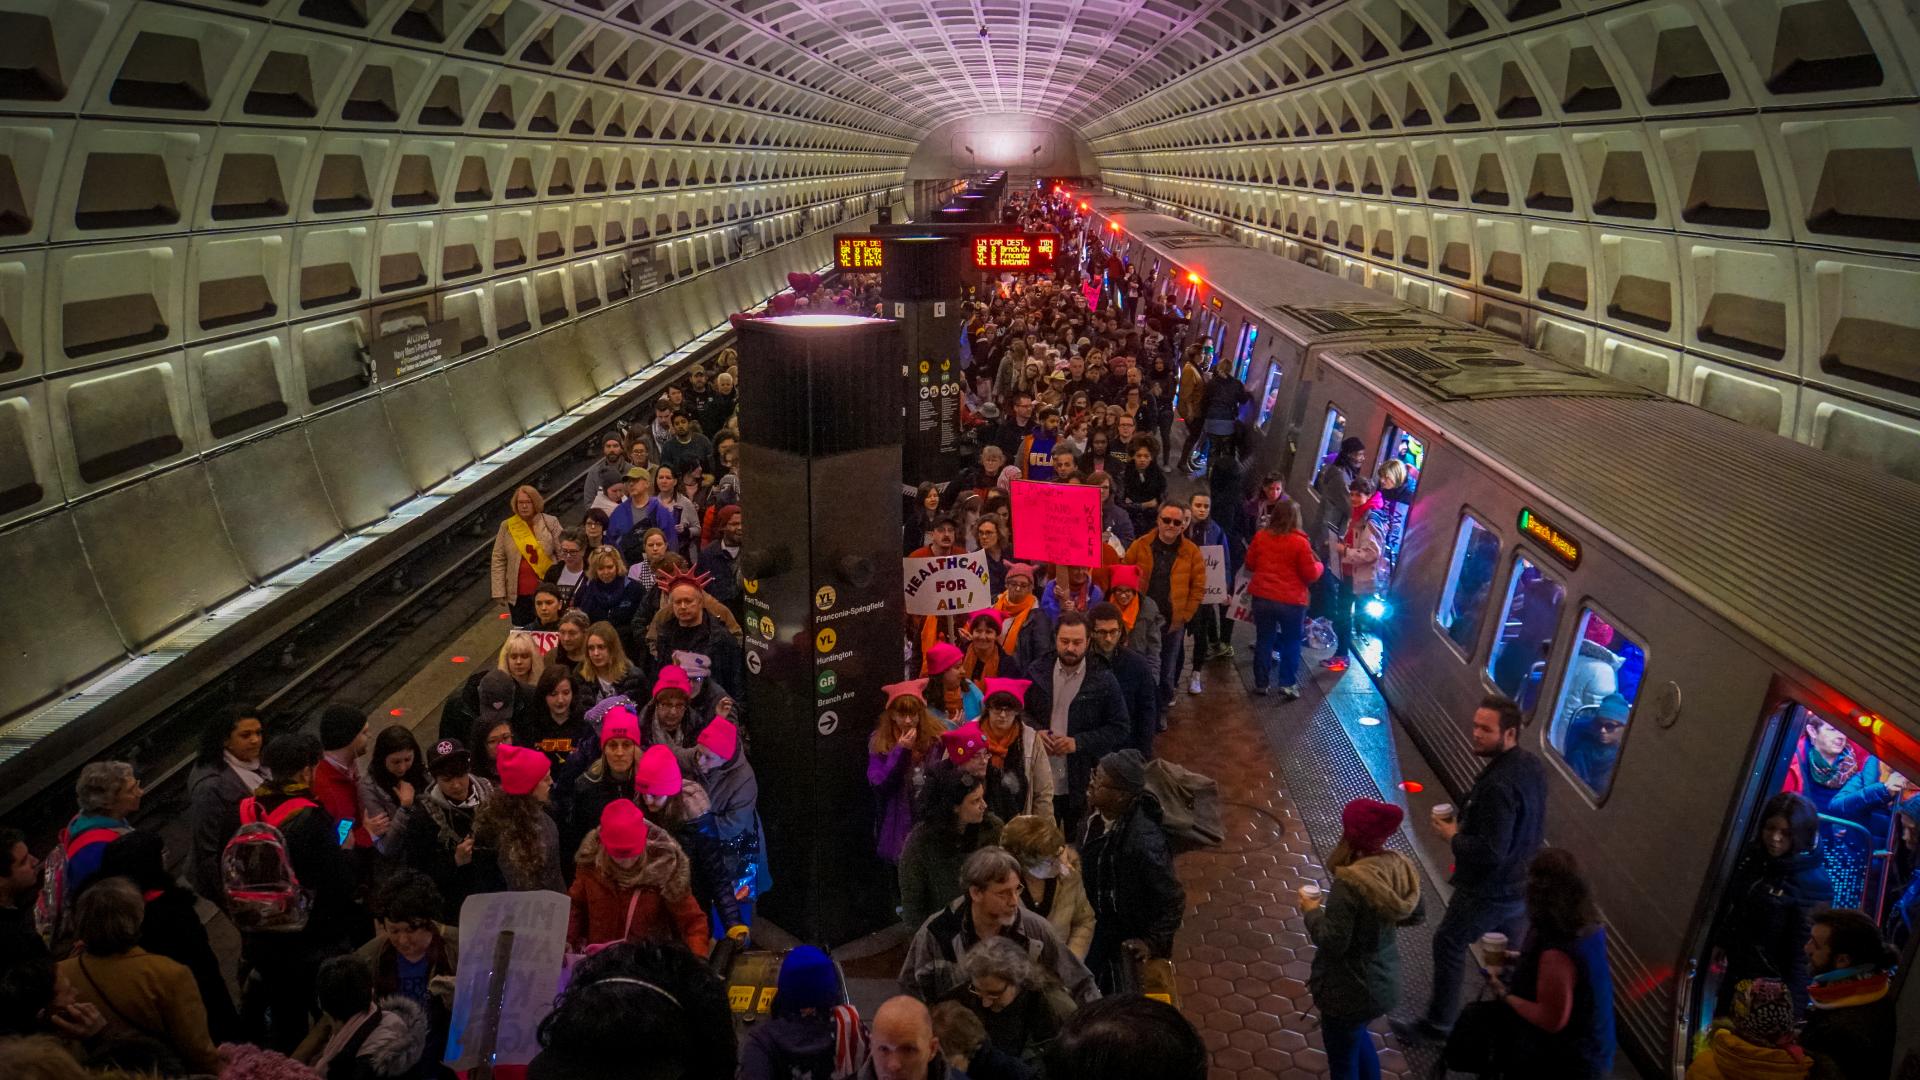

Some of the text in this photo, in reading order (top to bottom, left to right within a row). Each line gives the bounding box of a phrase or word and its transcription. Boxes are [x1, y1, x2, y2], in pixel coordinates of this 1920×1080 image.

[904, 557, 989, 597] HEALTHCARE
[935, 579, 967, 592] FOR
[819, 592, 833, 603] YL
[936, 592, 974, 611] ALL!
[815, 600, 885, 624] Franconia-Springfield
[746, 616, 758, 629] GR
[819, 635, 833, 646] YL
[816, 650, 853, 665] Huntington
[819, 675, 836, 688] GR
[817, 690, 855, 708] Branch Ave
